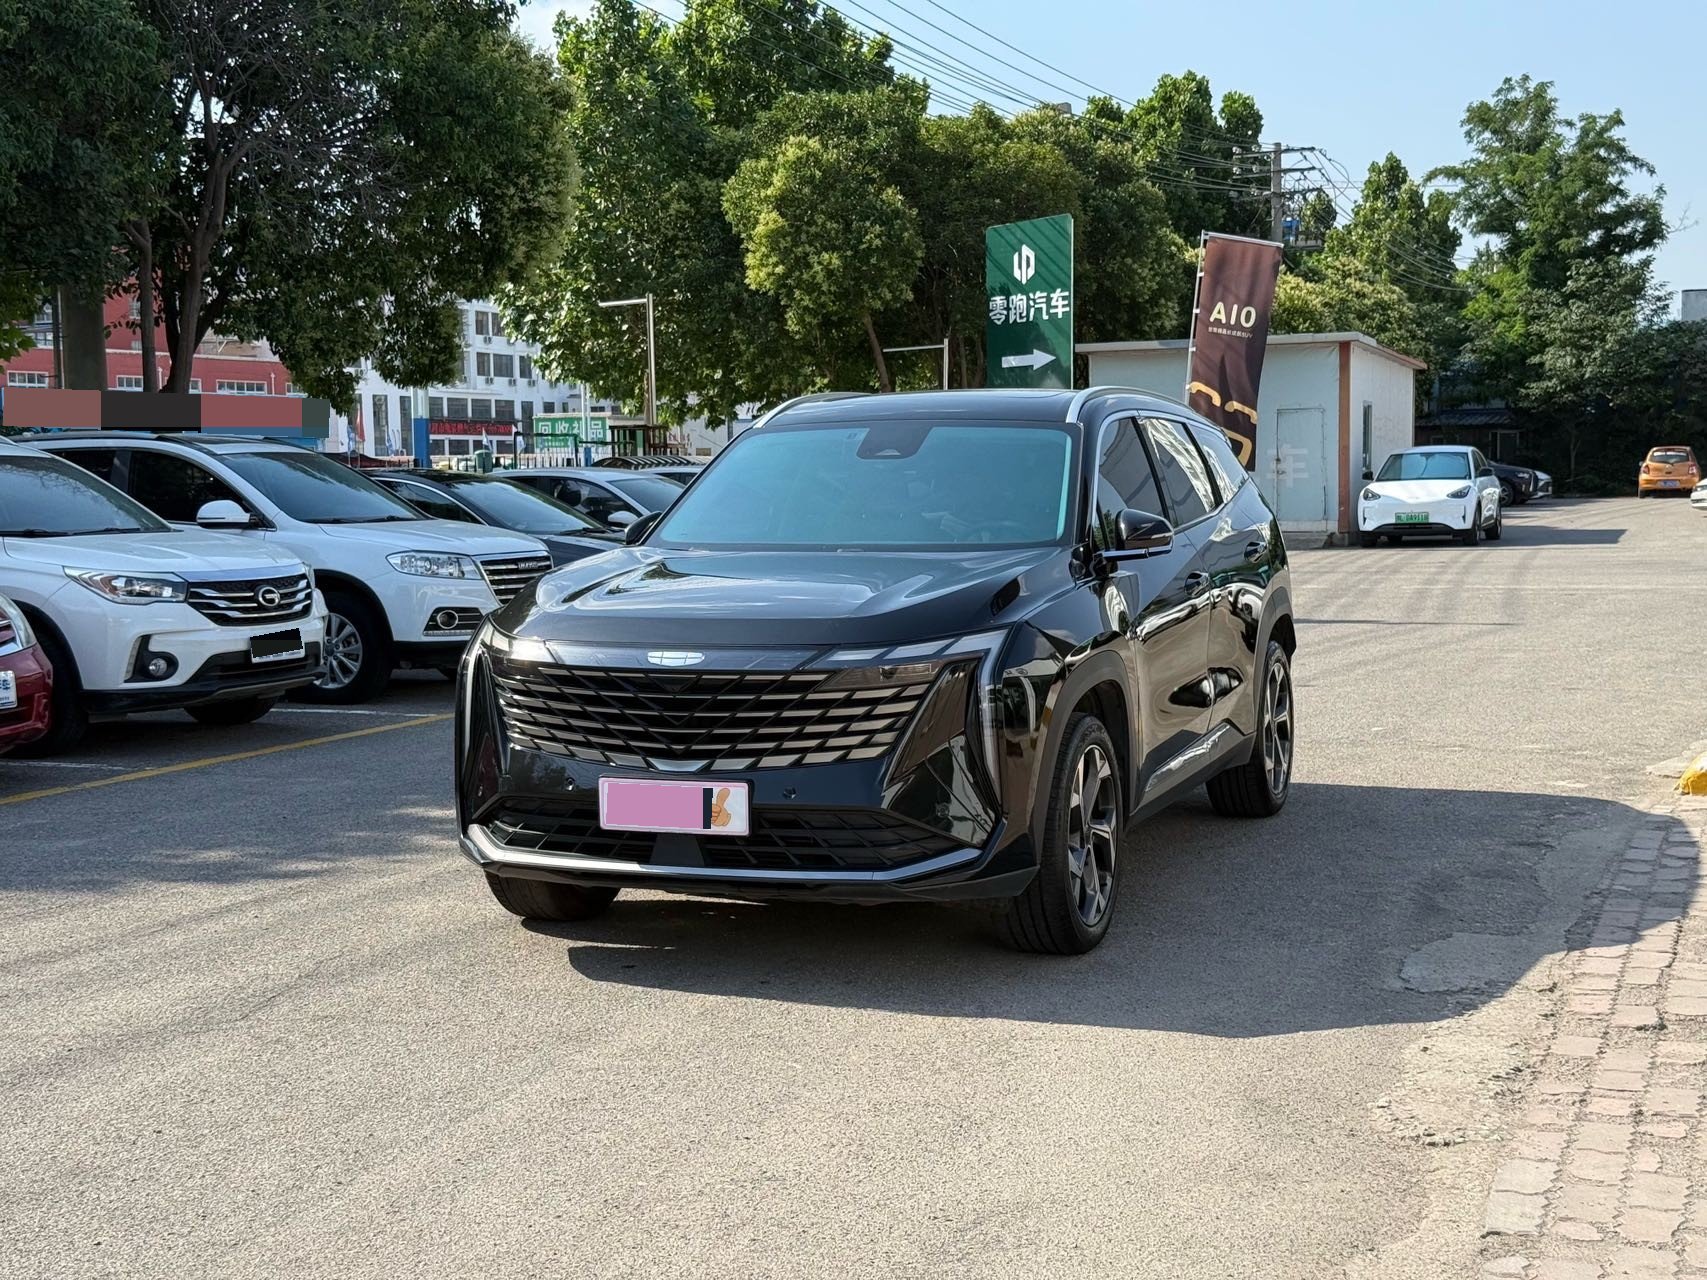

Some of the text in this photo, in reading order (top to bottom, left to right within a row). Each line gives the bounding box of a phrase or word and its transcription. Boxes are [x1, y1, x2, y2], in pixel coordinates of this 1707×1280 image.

[989, 288, 1070, 325] 零跑汽车
[1265, 443, 1308, 488] 车
[0, 679, 11, 690] 车
